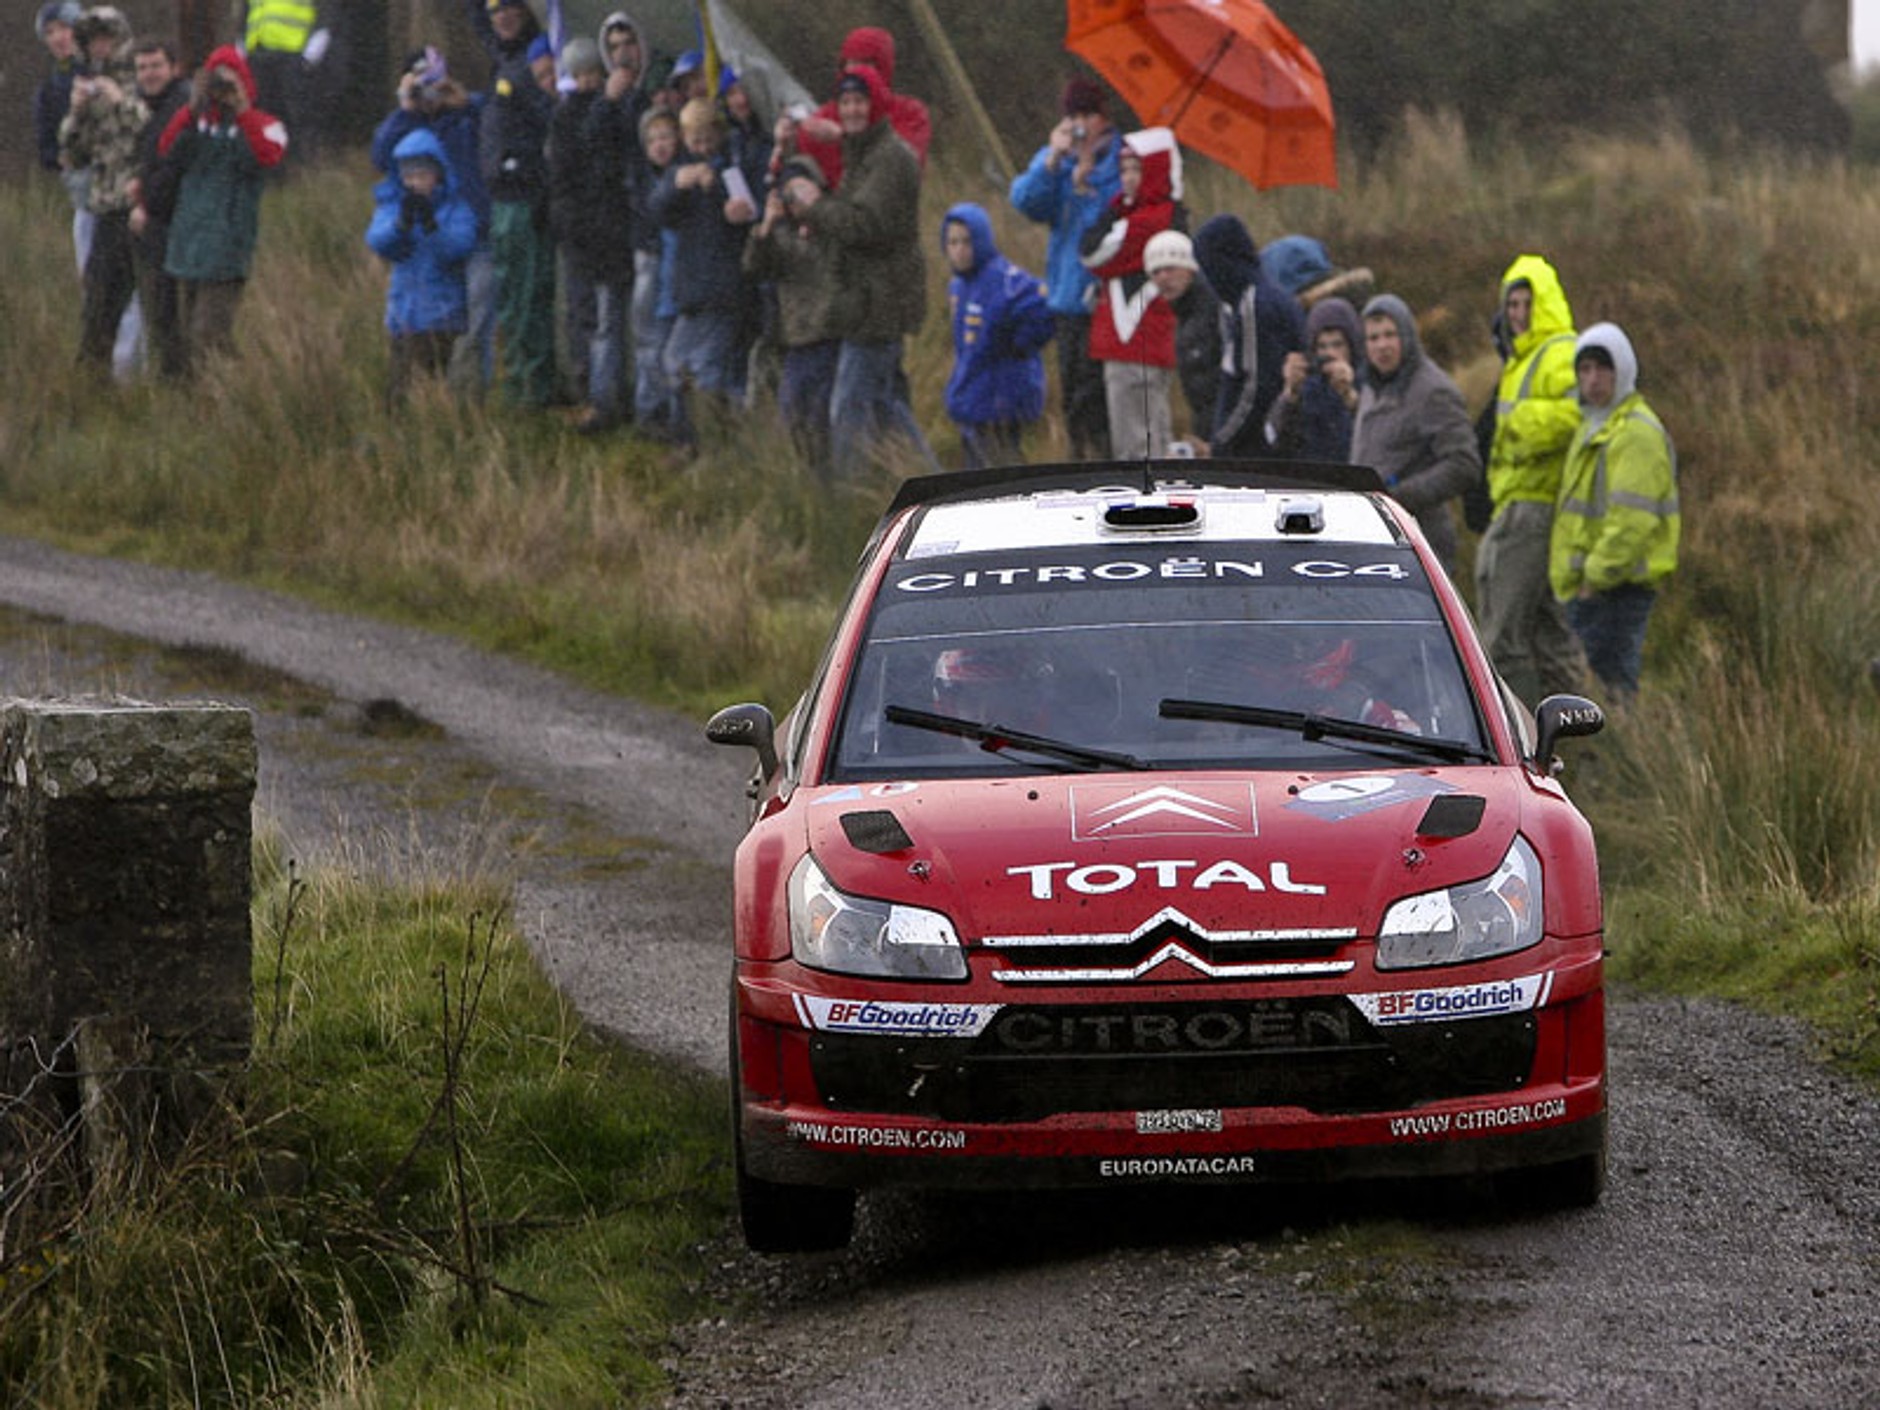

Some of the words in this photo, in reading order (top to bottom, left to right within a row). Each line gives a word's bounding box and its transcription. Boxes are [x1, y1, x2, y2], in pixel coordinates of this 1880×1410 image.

[896, 556, 1264, 591] CITROËN
[1290, 560, 1410, 581] C4
[1007, 859, 1327, 900] TOTAL
[827, 1002, 980, 1026] BFGoodrich
[1378, 983, 1523, 1015] BFGoodrich
[999, 1001, 1350, 1050] CITROËN
[1100, 1156, 1255, 1177] EURODATACAR
